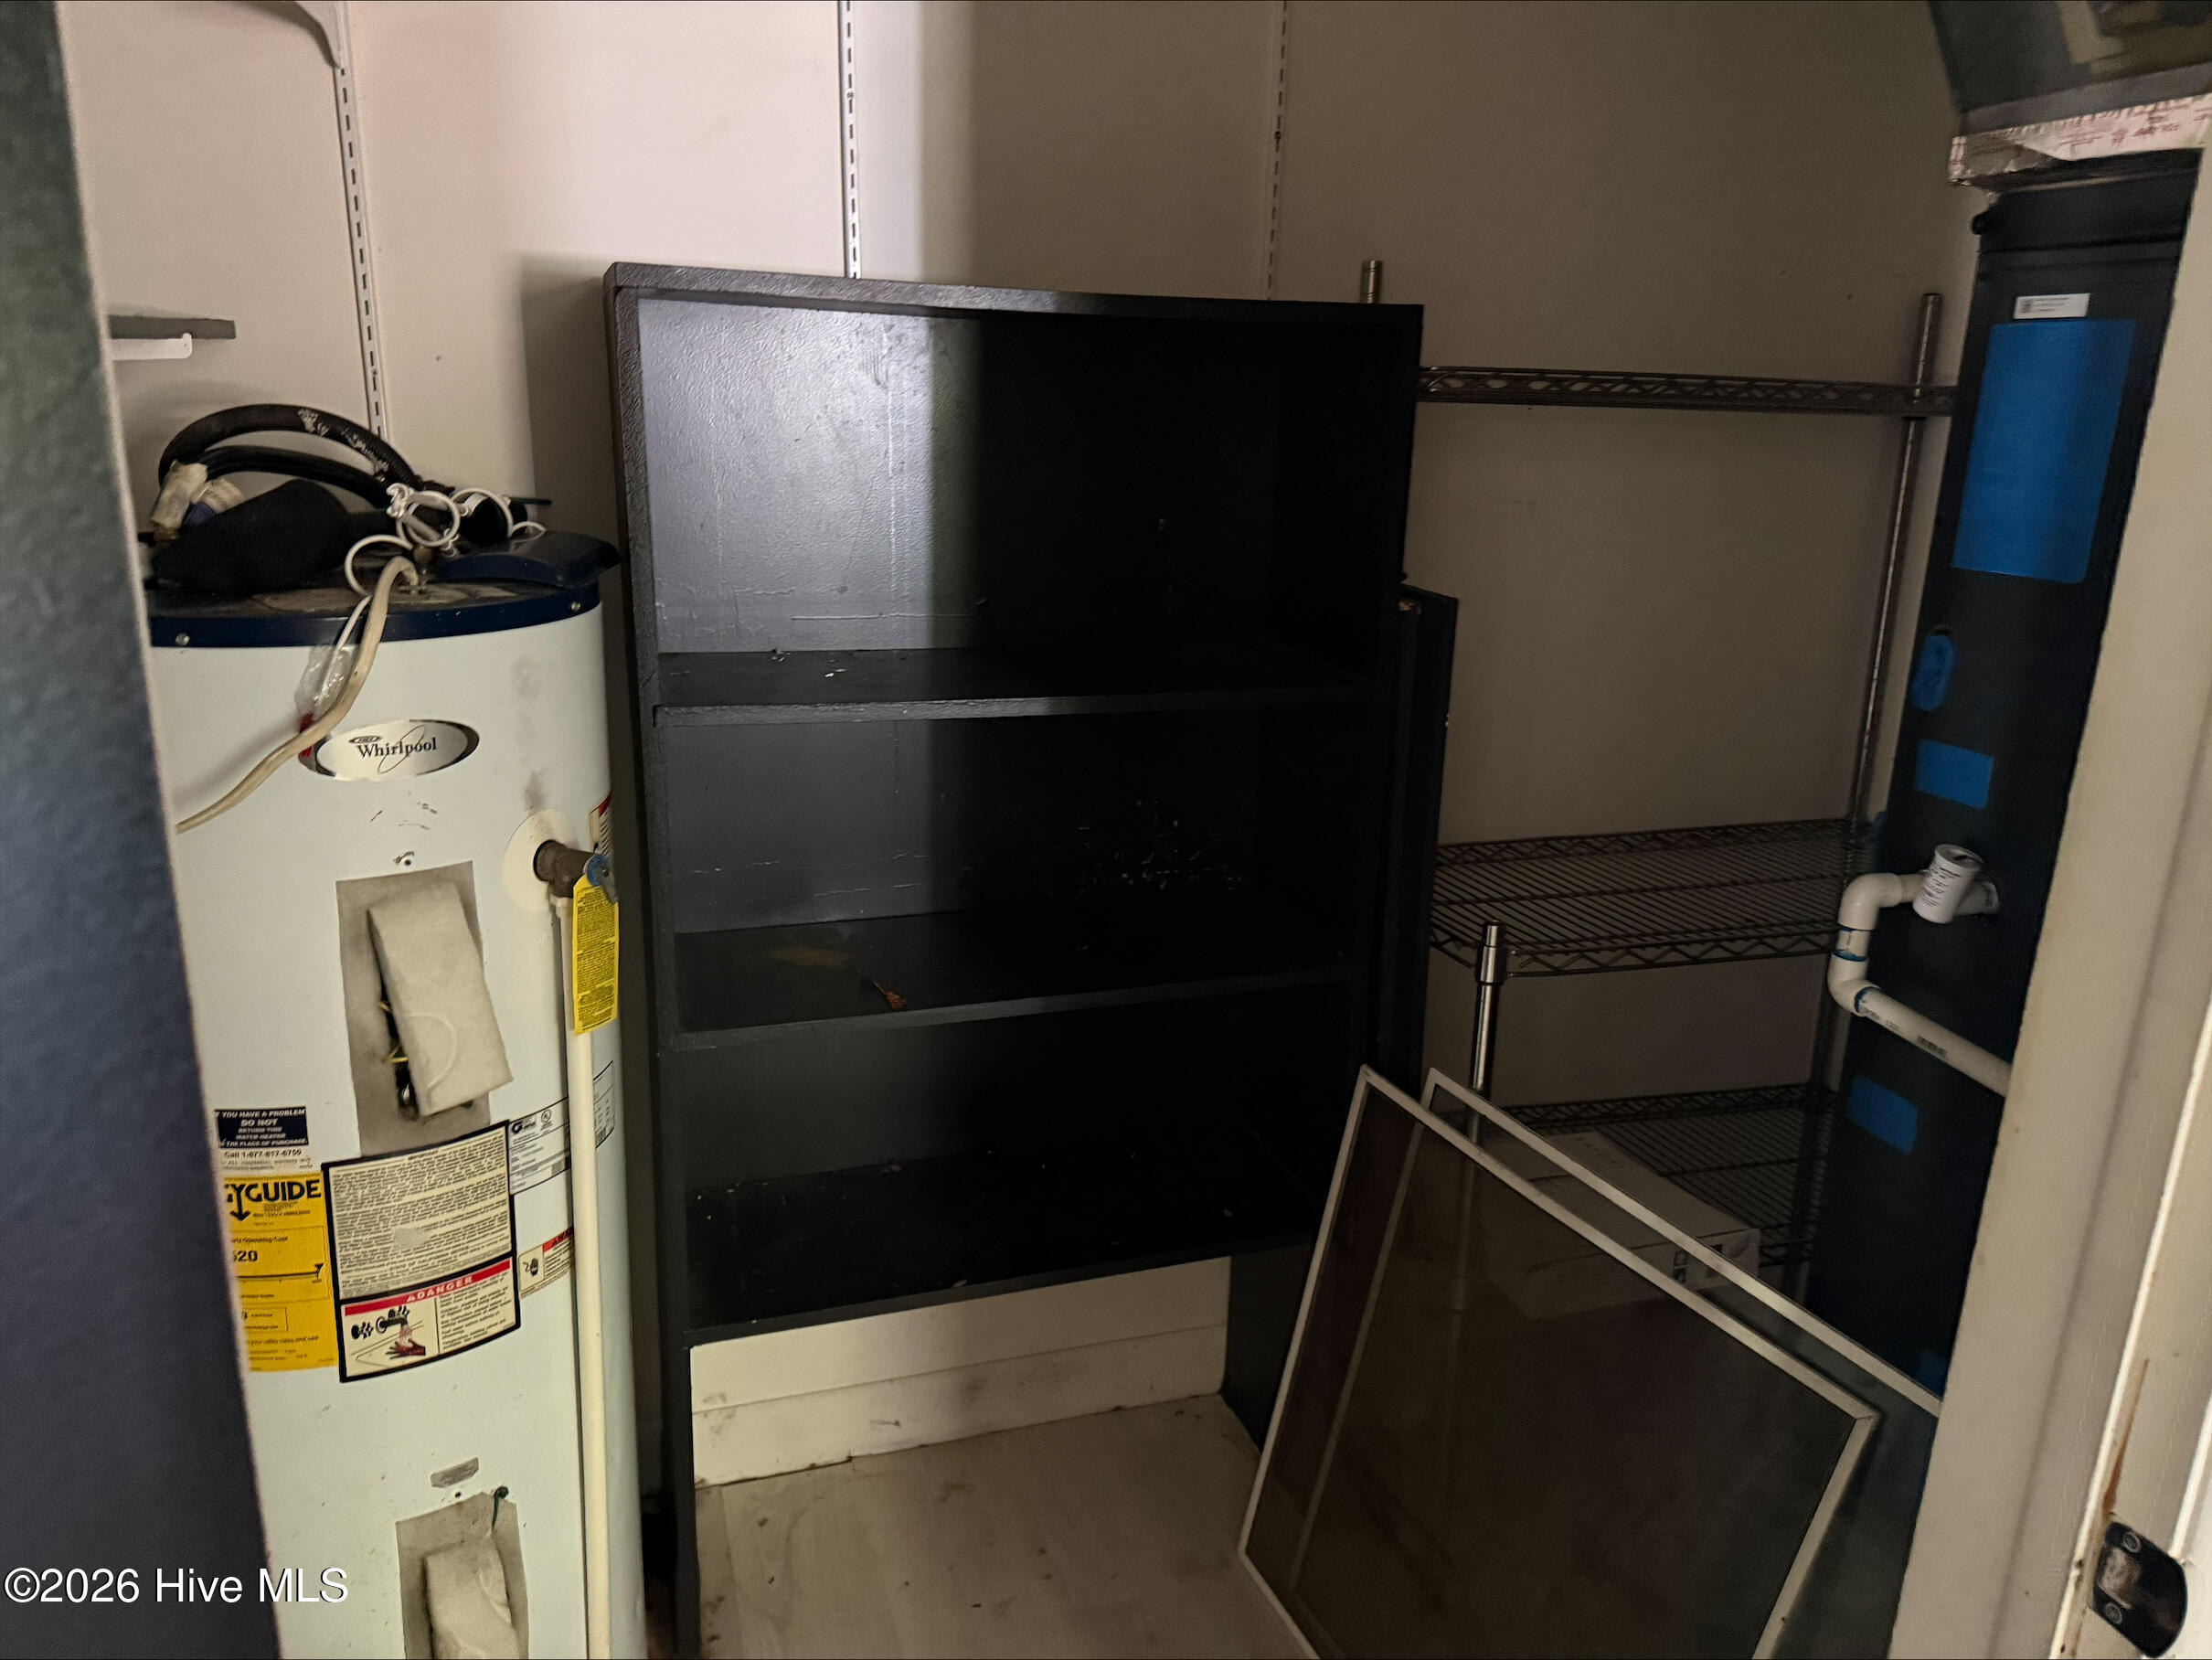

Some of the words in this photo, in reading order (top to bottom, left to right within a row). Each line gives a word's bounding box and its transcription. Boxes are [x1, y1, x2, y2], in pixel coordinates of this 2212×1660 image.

[356, 737, 437, 759] Whirlpool
[240, 1119, 255, 1127] DO
[257, 1118, 278, 1126] NOT
[269, 1109, 305, 1117] PROBLEM
[225, 1178, 322, 1204] YGUIDE
[416, 1276, 473, 1299] DANGER
